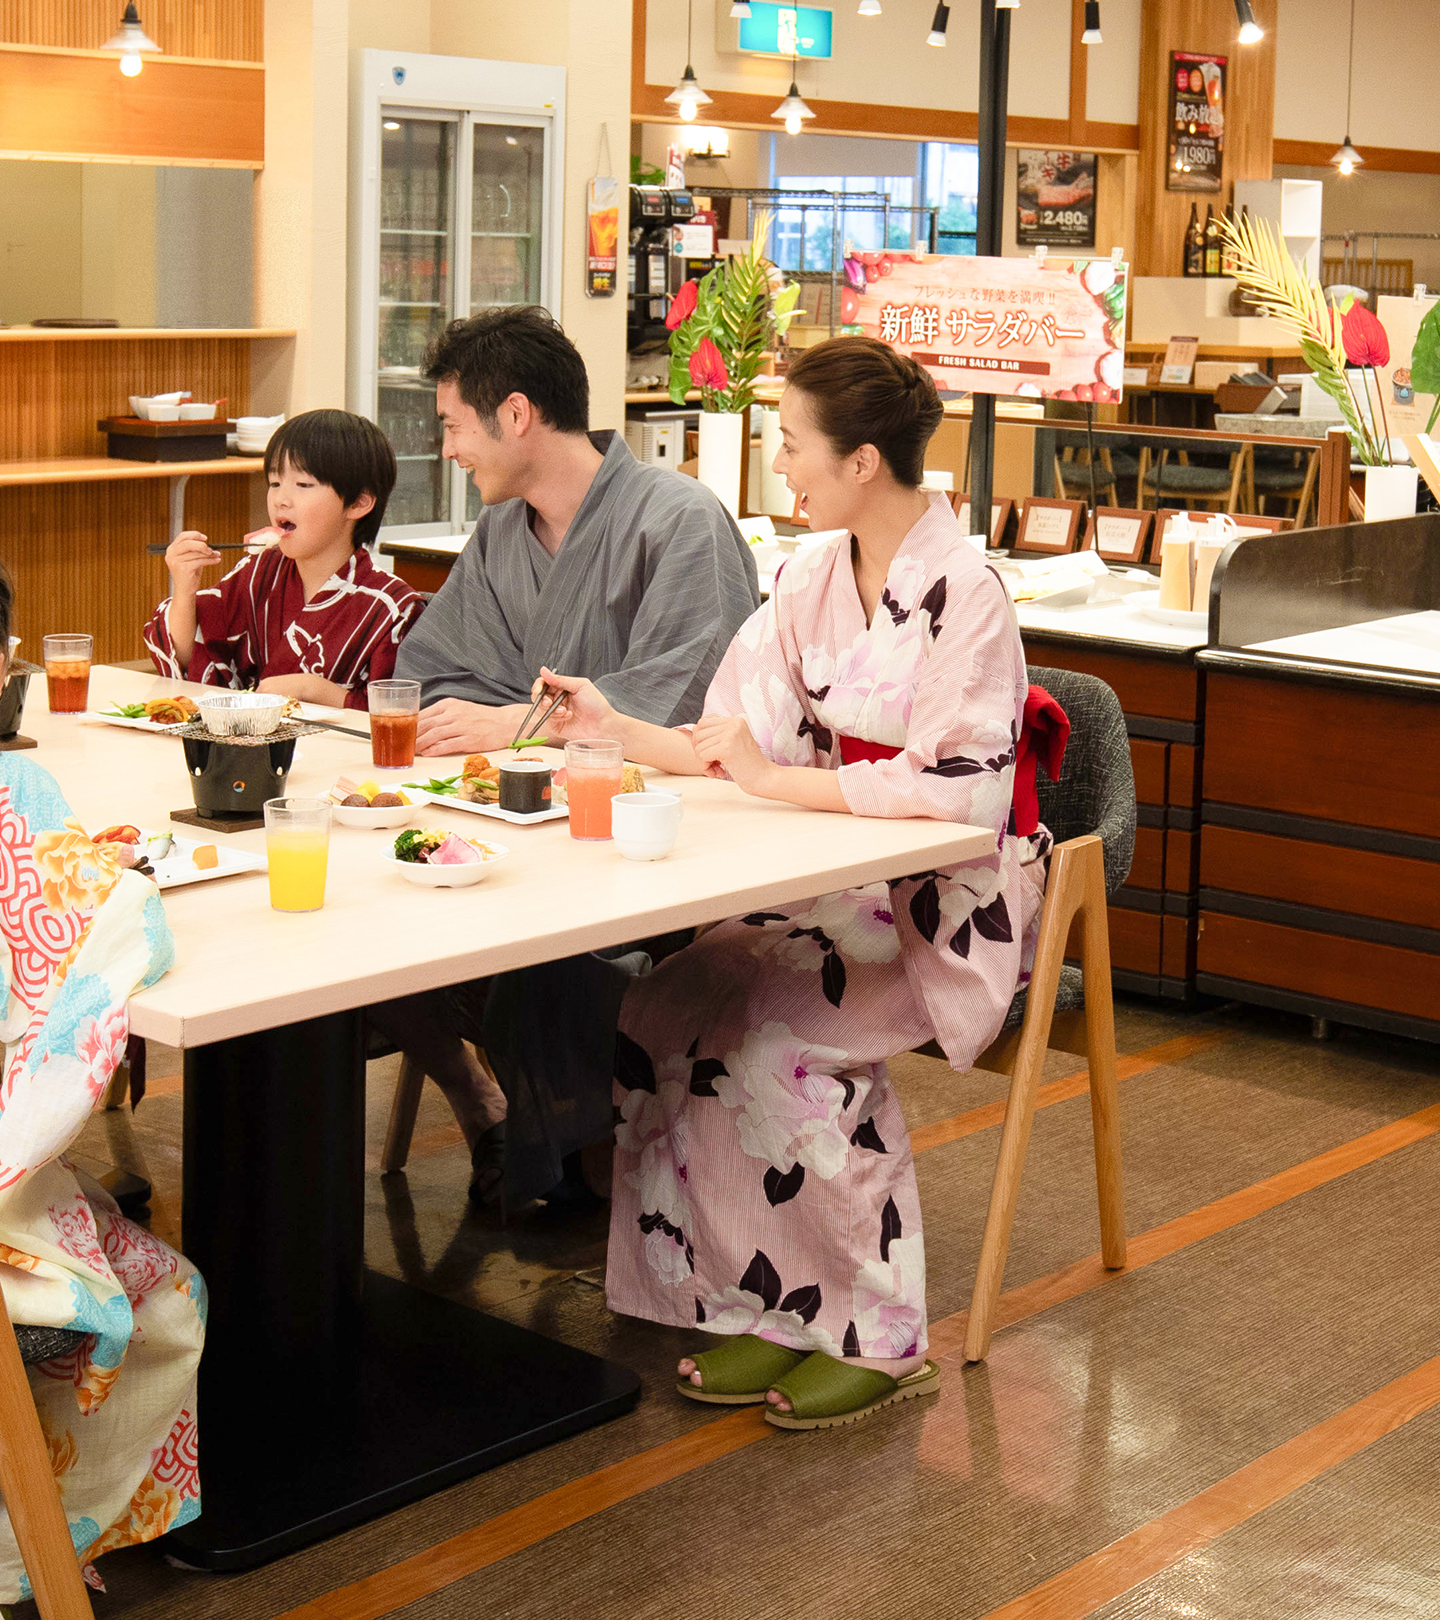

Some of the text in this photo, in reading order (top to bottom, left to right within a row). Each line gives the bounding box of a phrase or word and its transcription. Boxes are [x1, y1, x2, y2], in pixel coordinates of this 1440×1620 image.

[880, 304, 1085, 348] 新鮮 サラダバー
[938, 355, 1020, 371] FRESH SALAD BAR
